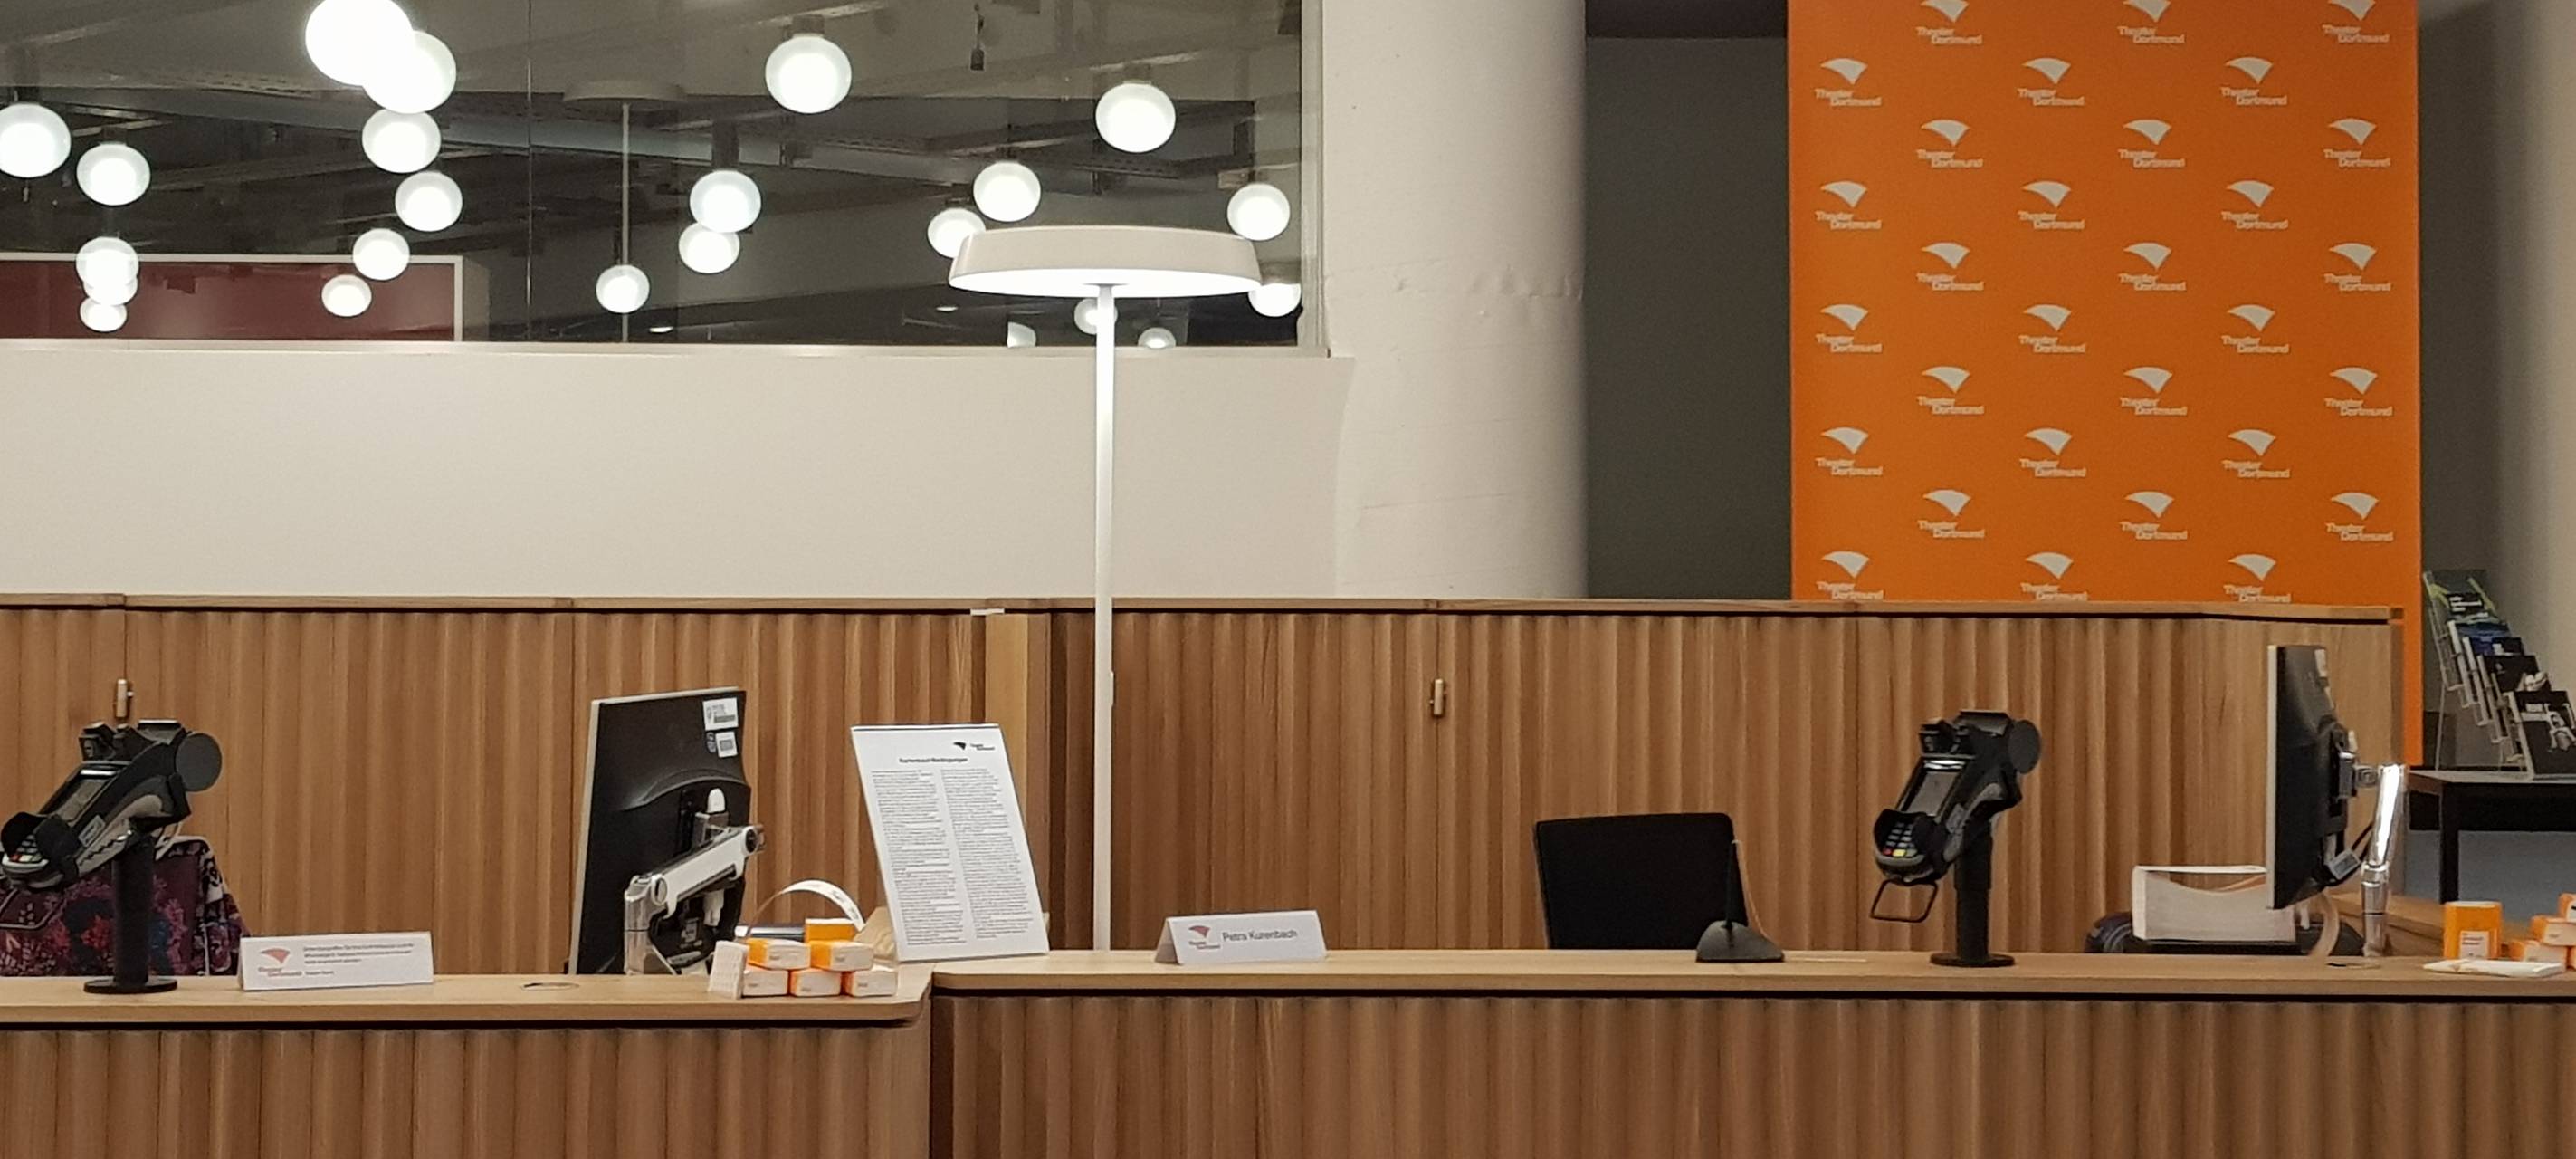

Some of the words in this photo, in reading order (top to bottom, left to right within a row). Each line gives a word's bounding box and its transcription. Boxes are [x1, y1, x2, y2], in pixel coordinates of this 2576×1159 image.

[1915, 26, 1954, 36] Theater
[2118, 25, 2157, 35] Theater
[2323, 25, 2361, 35] Theater
[1931, 34, 1981, 43] Dortmund
[2133, 33, 2184, 43] Dortmund
[2338, 33, 2389, 43] Dortmund
[1815, 89, 1854, 99] Theater
[2018, 88, 2056, 98] Theater
[2220, 88, 2259, 98] Theater
[1830, 96, 1881, 106] Dortmund
[2033, 95, 2084, 105] Dortmund
[2236, 95, 2286, 105] Dortmund
[1916, 149, 1955, 159] Theater
[2118, 149, 2157, 159] Theater
[2323, 149, 2362, 159] Theater
[1932, 157, 1982, 168] Dortmund
[2133, 157, 2184, 168] Dortmund
[2339, 157, 2390, 167] Dortmund
[1815, 212, 1854, 222] Theater
[2018, 211, 2056, 221] Theater
[2221, 212, 2260, 222] Theater
[1830, 219, 1881, 229] Dortmund
[2033, 218, 2084, 228] Dortmund
[2237, 219, 2288, 229] Dortmund
[1916, 273, 1955, 283] Theater
[2119, 273, 2158, 283] Theater
[2323, 273, 2362, 283] Theater
[1932, 280, 1983, 290] Dortmund
[2134, 280, 2186, 290] Dortmund
[2339, 281, 2390, 291] Dortmund
[1816, 334, 1855, 344] Theater
[2018, 335, 2057, 345] Theater
[2221, 335, 2260, 345] Theater
[1831, 341, 1882, 352] Dortmund
[2034, 342, 2085, 352] Dortmund
[2237, 342, 2288, 352] Dortmund
[1917, 397, 1956, 407] Theater
[2120, 398, 2159, 407] Theater
[2324, 398, 2363, 408] Theater
[1932, 404, 1984, 414] Dortmund
[2135, 405, 2187, 415] Dortmund
[2340, 406, 2391, 416] Dortmund
[1816, 458, 1855, 468] Theater
[2019, 459, 2058, 469] Theater
[2222, 461, 2261, 471] Theater
[1831, 465, 1883, 475] Dortmund
[2035, 466, 2085, 476] Dortmund
[2237, 468, 2289, 478] Dortmund
[1918, 521, 1957, 531] Theater
[2120, 522, 2159, 532] Theater
[2325, 523, 2364, 533] Theater
[1933, 528, 1984, 538] Dortmund
[2135, 529, 2187, 540] Dortmund
[2341, 531, 2393, 541] Dortmund
[1816, 582, 1855, 592] Theater
[2019, 583, 2058, 593] Theater
[2223, 585, 2262, 595] Theater
[1831, 589, 1883, 600] Dortmund
[2035, 590, 2086, 601] Dortmund
[2238, 592, 2291, 602] Dortmund
